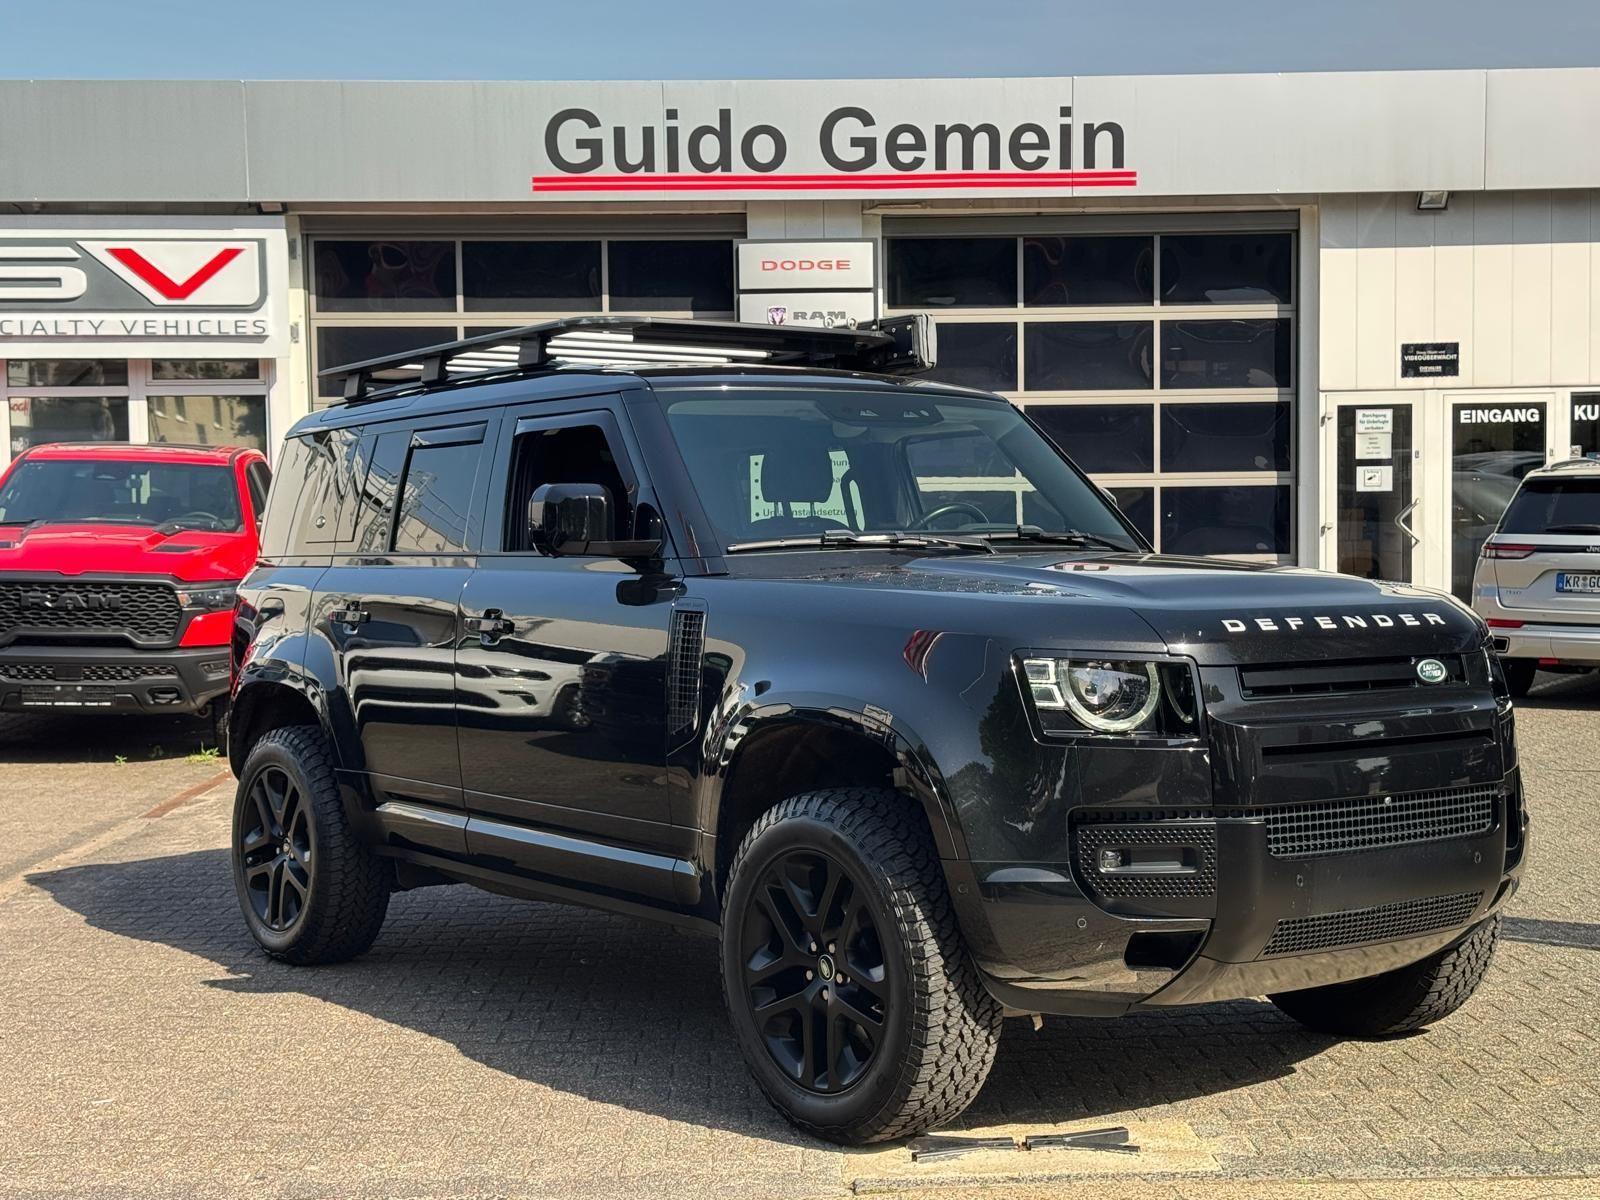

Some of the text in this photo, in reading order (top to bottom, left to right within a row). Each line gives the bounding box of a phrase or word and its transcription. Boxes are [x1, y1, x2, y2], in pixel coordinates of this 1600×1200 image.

[544, 105, 1126, 174] Guido Gemein
[761, 260, 851, 271] DODGE
[793, 311, 847, 320] RAM
[119, 319, 267, 335] VEHICLES
[1460, 408, 1540, 424] EINGANG
[1574, 404, 1600, 421] KU
[1565, 575, 1580, 588] KR
[21, 592, 121, 608] RAM
[1221, 611, 1447, 634] DEFENDER
